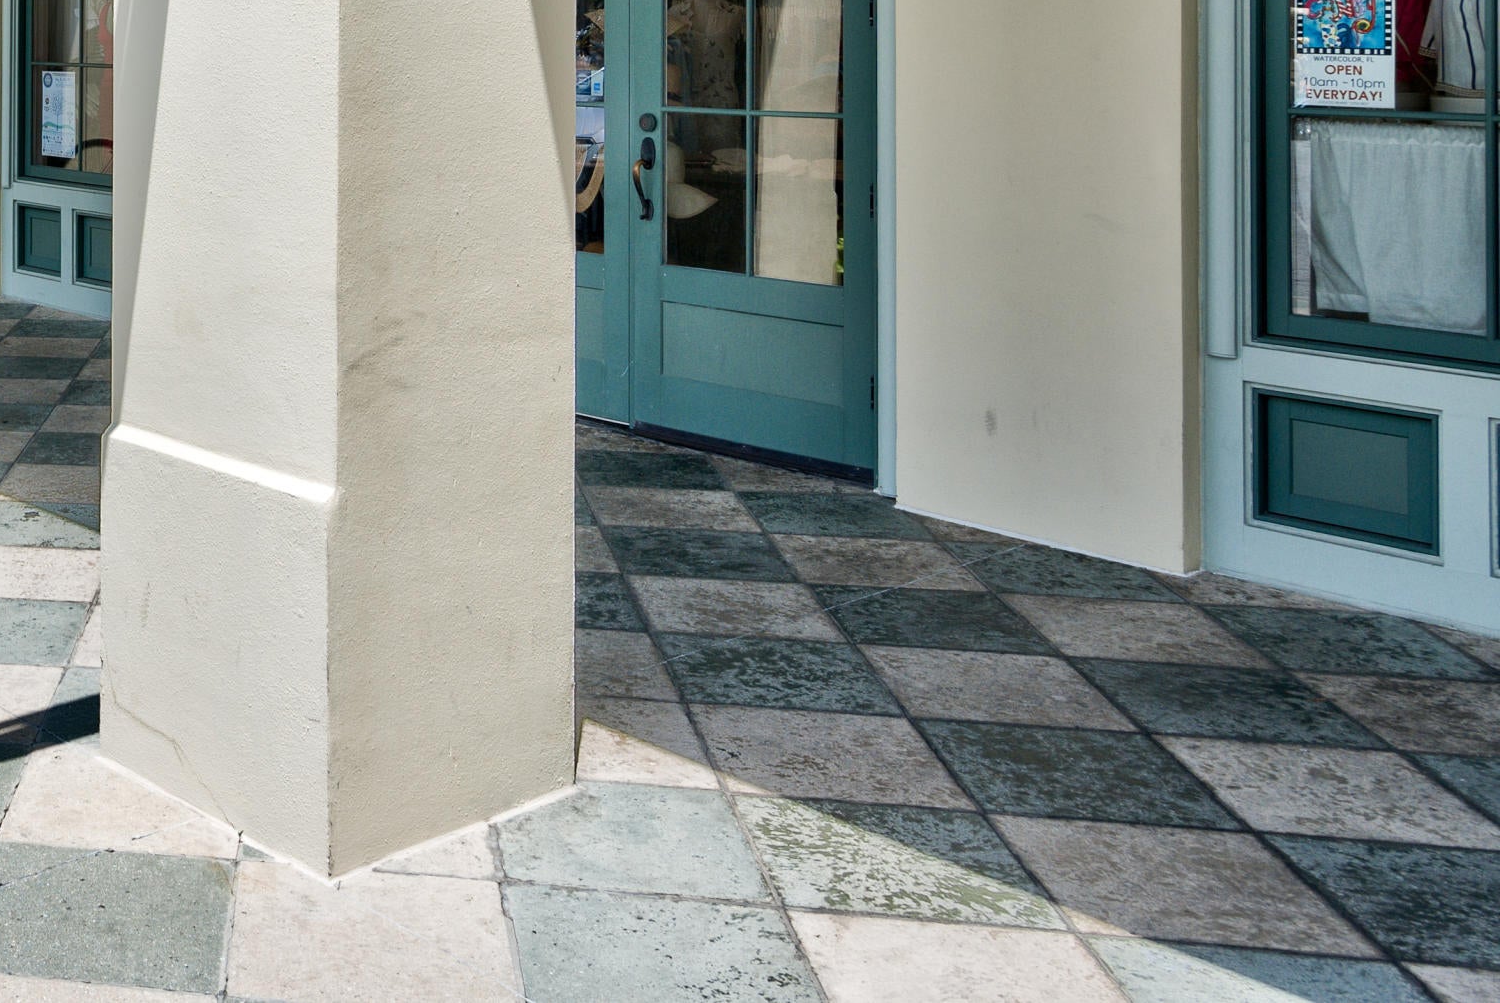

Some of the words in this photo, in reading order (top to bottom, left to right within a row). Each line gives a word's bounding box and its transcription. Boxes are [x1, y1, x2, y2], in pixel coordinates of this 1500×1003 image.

[1324, 64, 1362, 75] OPEN
[1304, 76, 1338, 87] 10am
[1305, 88, 1383, 102] EVERYDAY!
